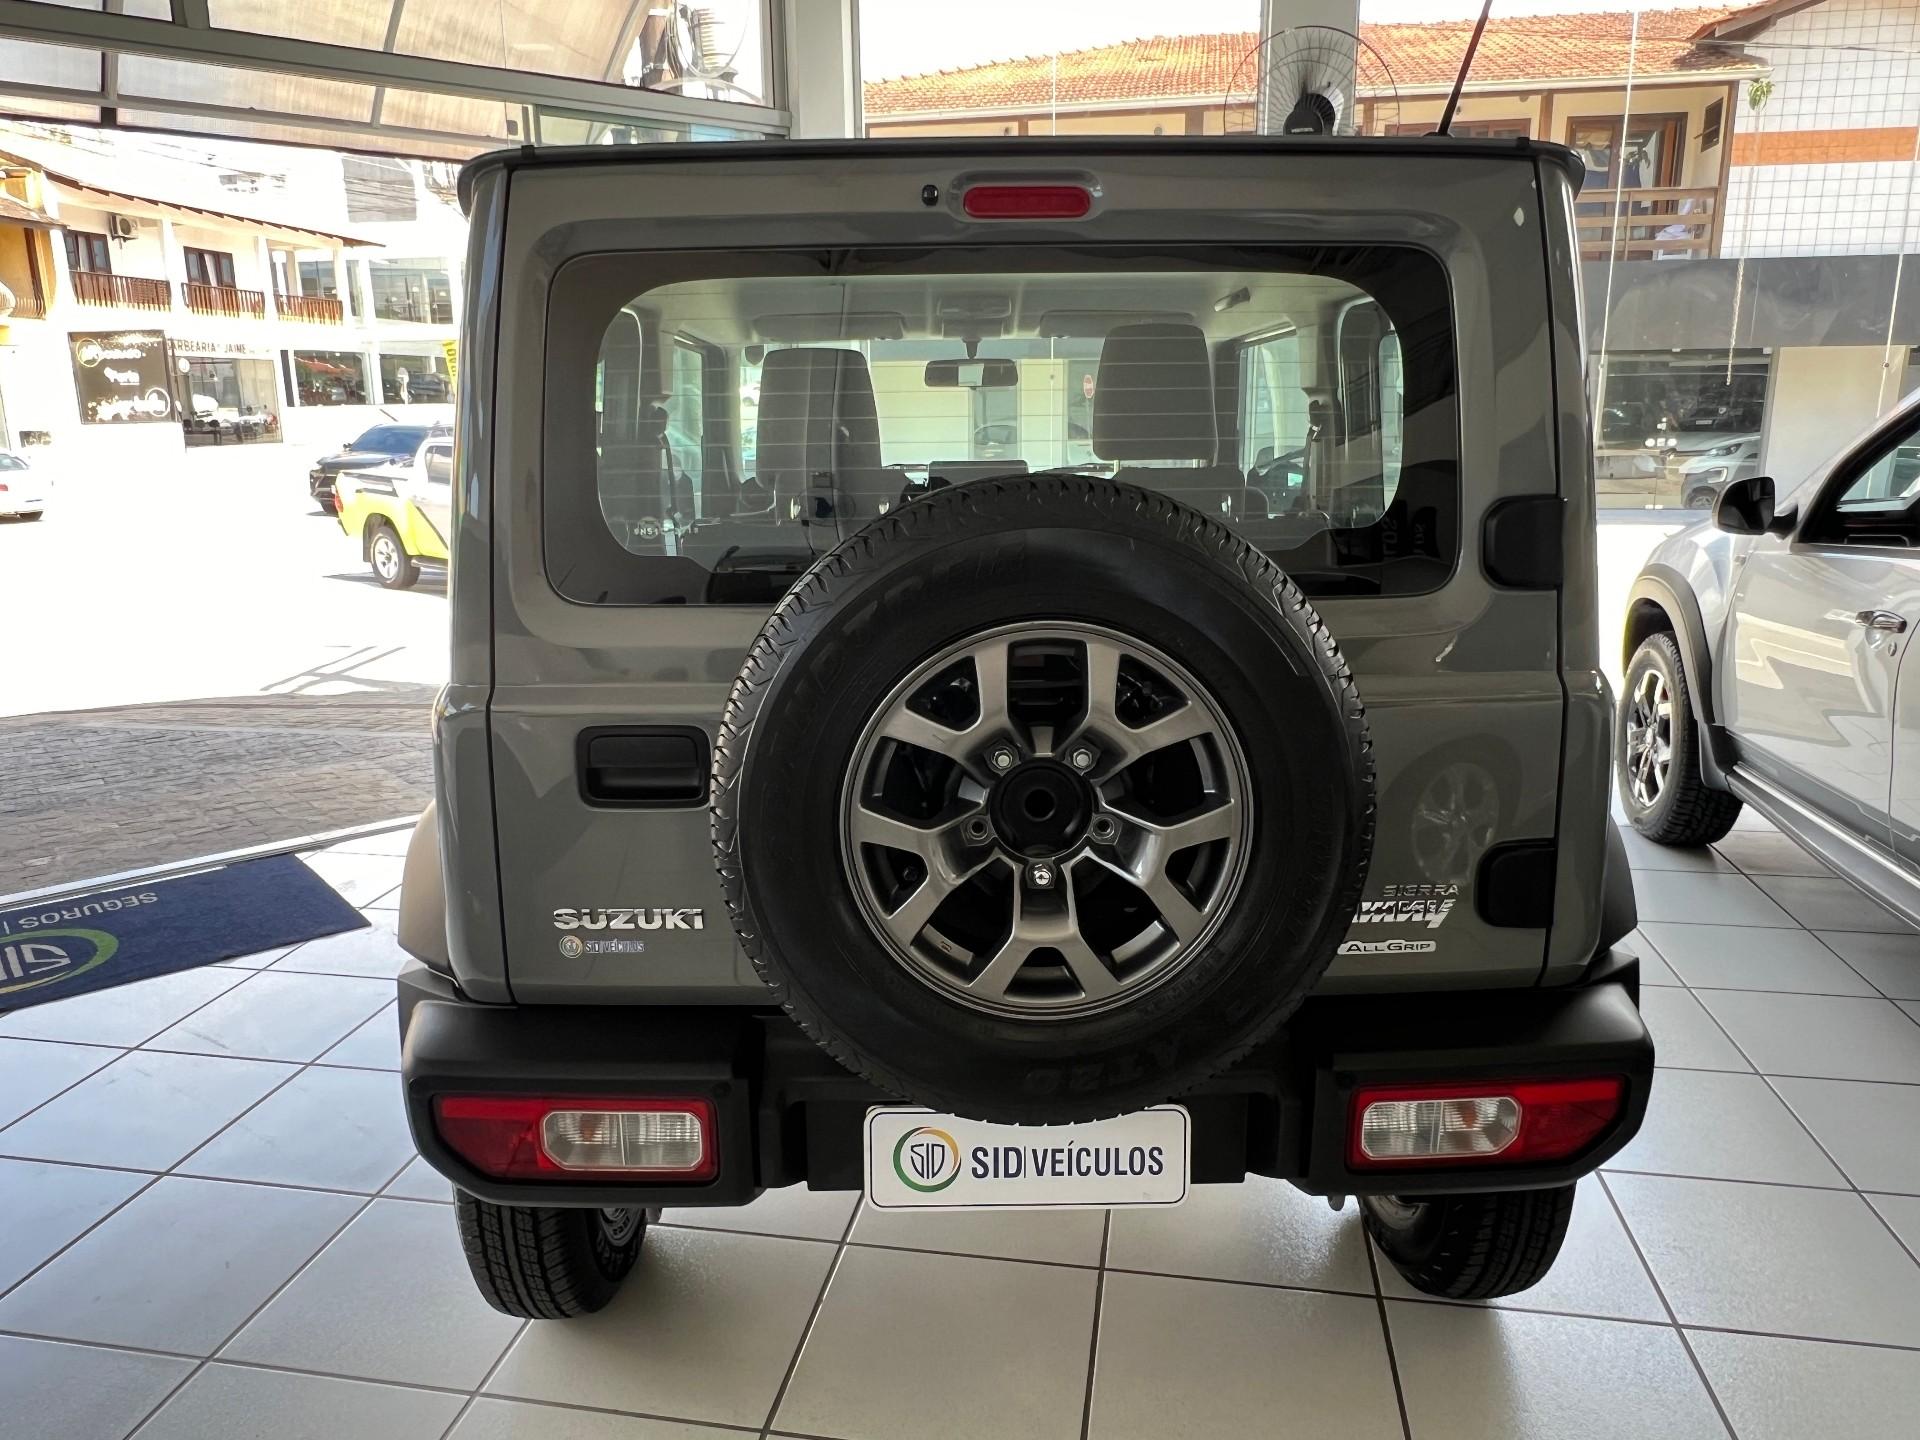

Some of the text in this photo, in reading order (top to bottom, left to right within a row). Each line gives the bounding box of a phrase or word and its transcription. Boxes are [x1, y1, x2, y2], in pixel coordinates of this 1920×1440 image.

[224, 343, 247, 355] JAIME
[1383, 884, 1459, 898] SIERRA
[18, 891, 159, 929] SEGUROS
[553, 908, 704, 930] SUZUKI
[910, 1143, 945, 1180] SID
[971, 1140, 1164, 1179] SID VEÍCULOS
